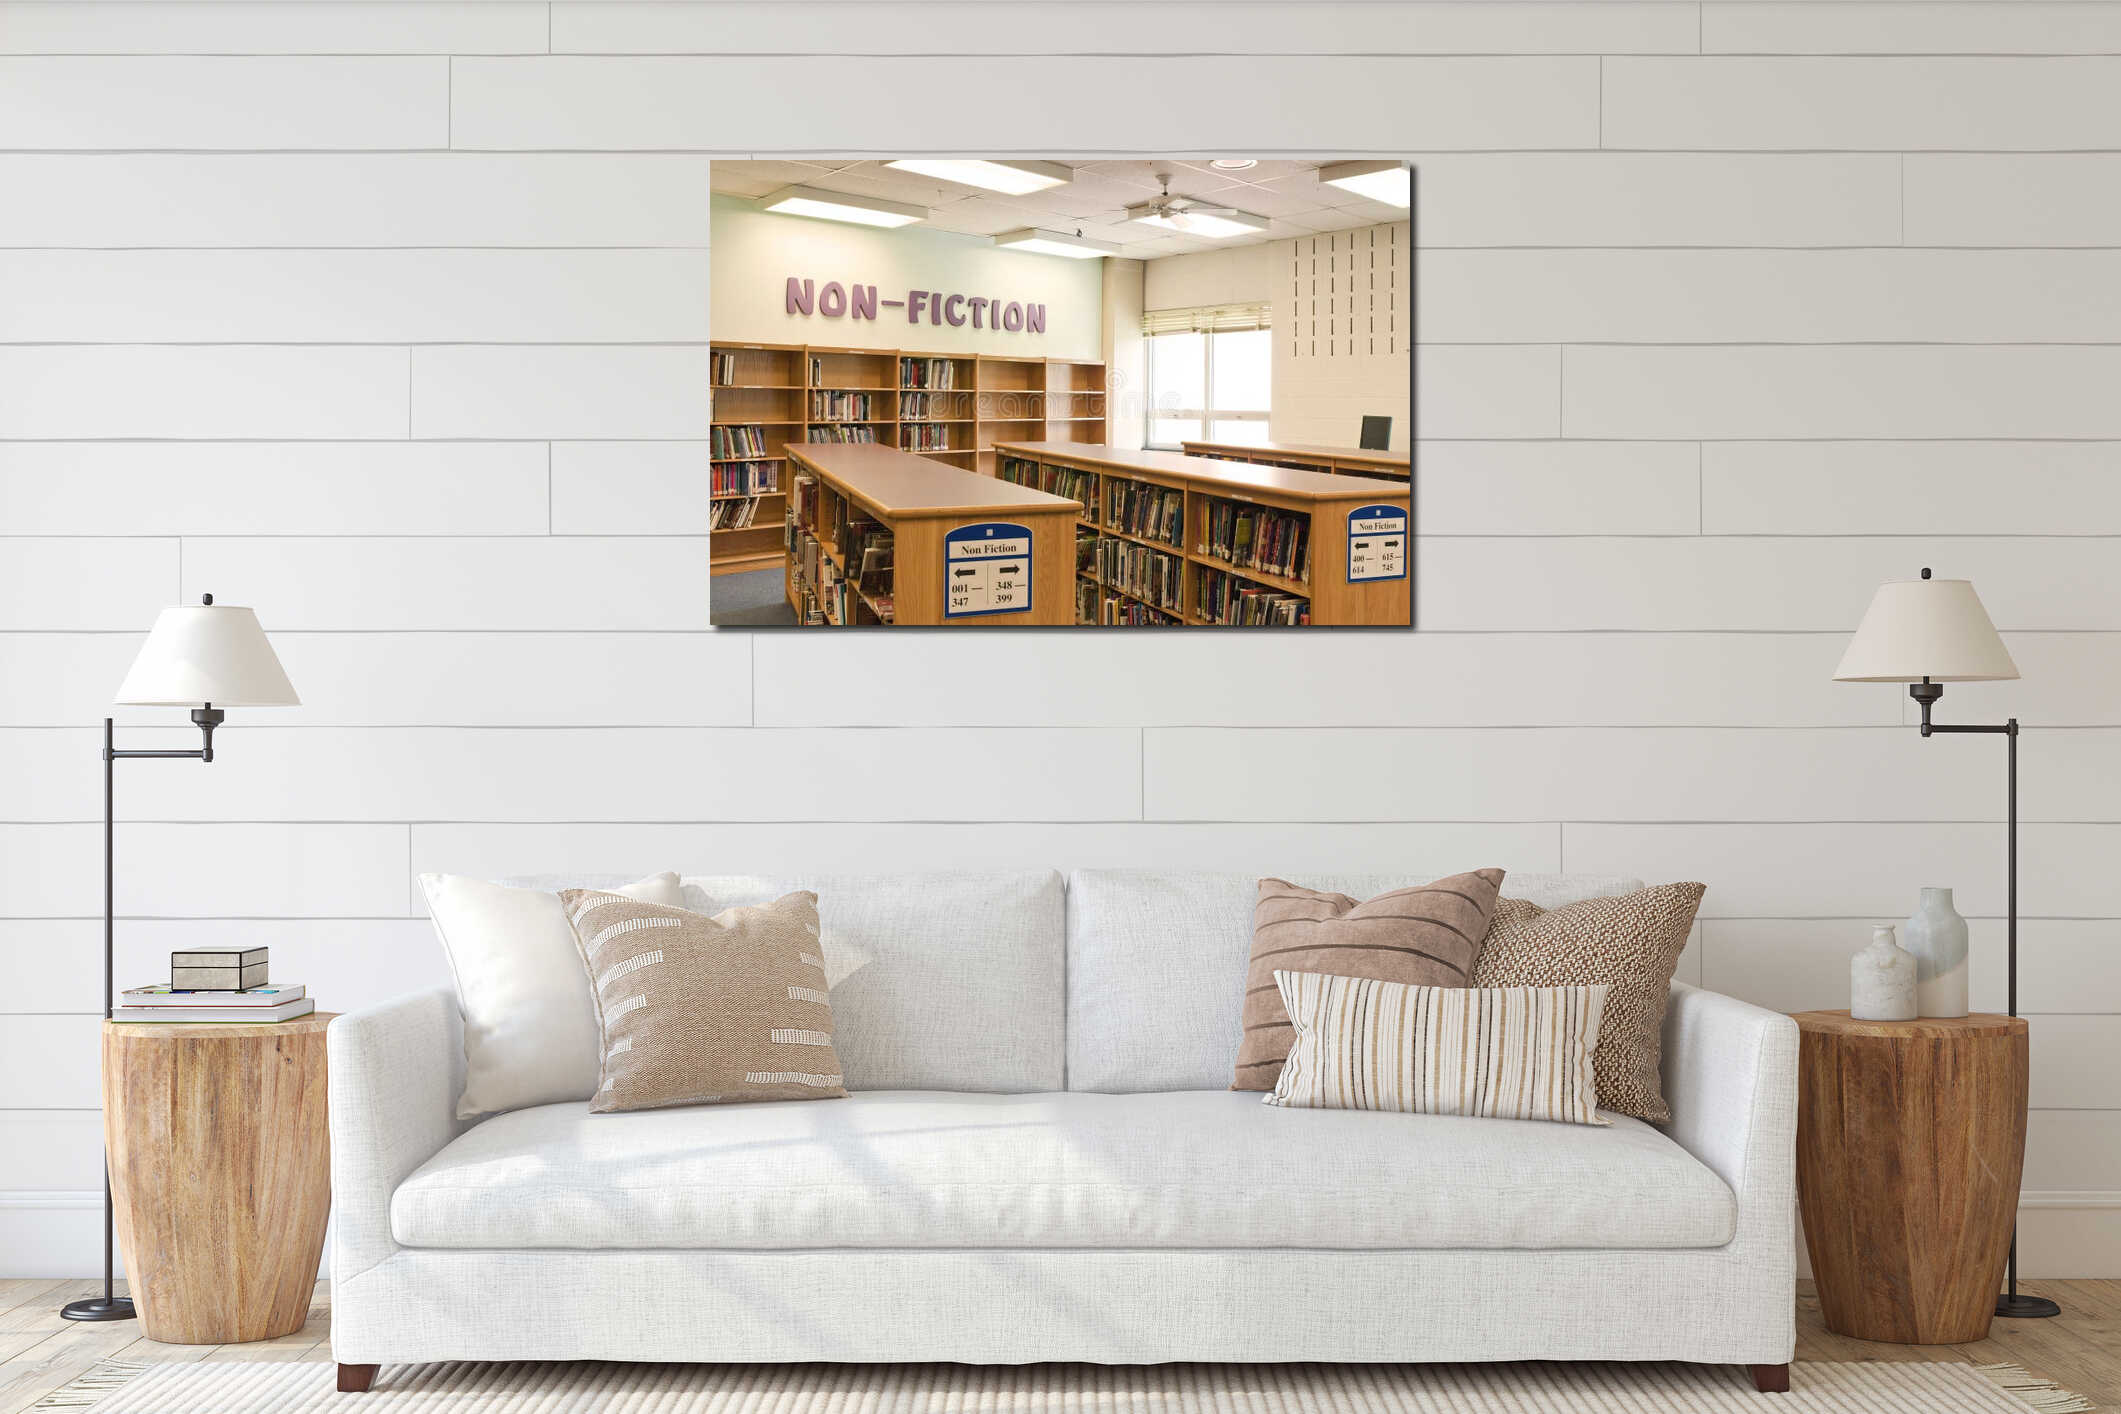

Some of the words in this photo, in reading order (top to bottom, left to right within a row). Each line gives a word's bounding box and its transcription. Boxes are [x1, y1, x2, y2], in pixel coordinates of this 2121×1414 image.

[786, 277, 1046, 334] NON-FICTION
[1360, 523, 1373, 531] Non
[1375, 521, 1397, 530] Fiction
[961, 545, 981, 555] Non
[984, 543, 1017, 554] Fiction
[1352, 555, 1365, 563] 400
[1382, 553, 1394, 561] 615
[1352, 565, 1364, 574] 614
[951, 584, 968, 593] 001
[995, 581, 1013, 591] 348
[951, 597, 969, 608] 347
[995, 594, 1013, 604] 399
